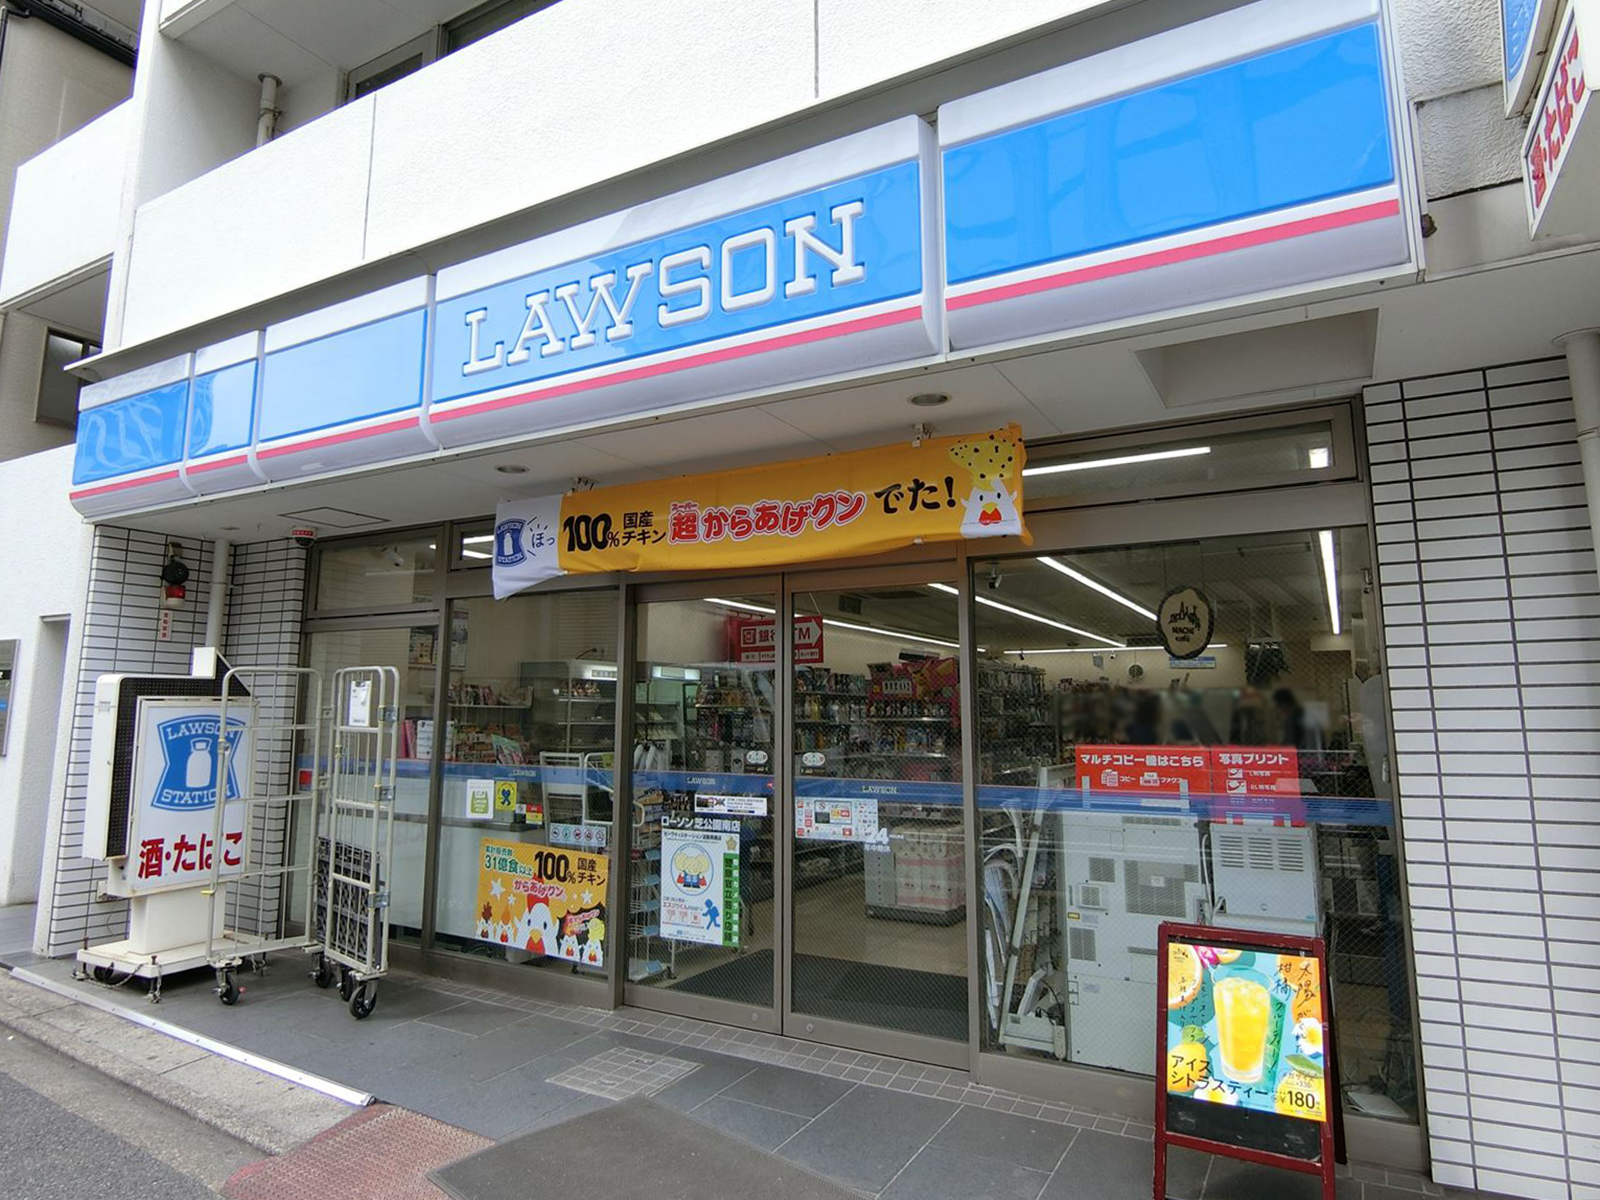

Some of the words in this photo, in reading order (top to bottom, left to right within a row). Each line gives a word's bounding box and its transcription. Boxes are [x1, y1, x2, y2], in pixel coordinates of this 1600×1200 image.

[463, 199, 865, 376] LAWSON
[623, 511, 653, 529] 国産
[669, 492, 865, 542] 超からあげクン
[563, 513, 620, 552] 100%
[622, 529, 667, 546] チキン
[1218, 753, 1289, 765] 写真プリント
[862, 785, 897, 795] LAWSON
[534, 851, 576, 884] 100%
[577, 858, 598, 872] 国産
[577, 872, 605, 886] チキン
[514, 880, 564, 897] からあげクン
[1272, 963, 1292, 1001] 柑橘
[1171, 1055, 1211, 1074] アイス
[1171, 1071, 1268, 1098] シトラスティー
